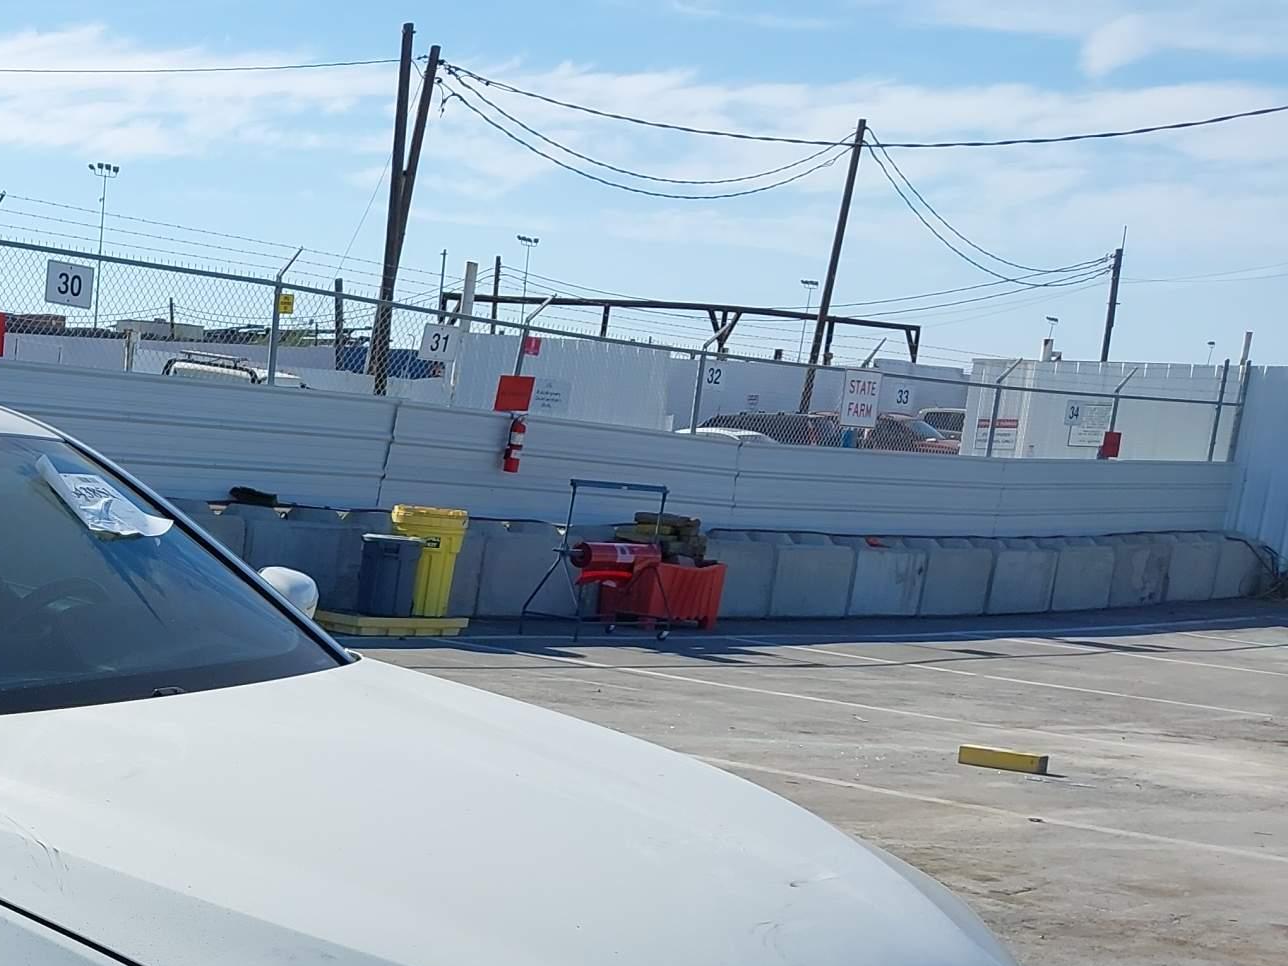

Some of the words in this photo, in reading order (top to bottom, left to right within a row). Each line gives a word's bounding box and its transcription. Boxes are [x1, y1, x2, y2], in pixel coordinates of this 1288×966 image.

[57, 272, 82, 297] 30
[430, 333, 450, 353] 31
[707, 367, 722, 385] 32
[849, 379, 877, 396] STATE
[896, 389, 910, 405] 33
[847, 402, 873, 418] FARM
[1068, 405, 1080, 420] 34
